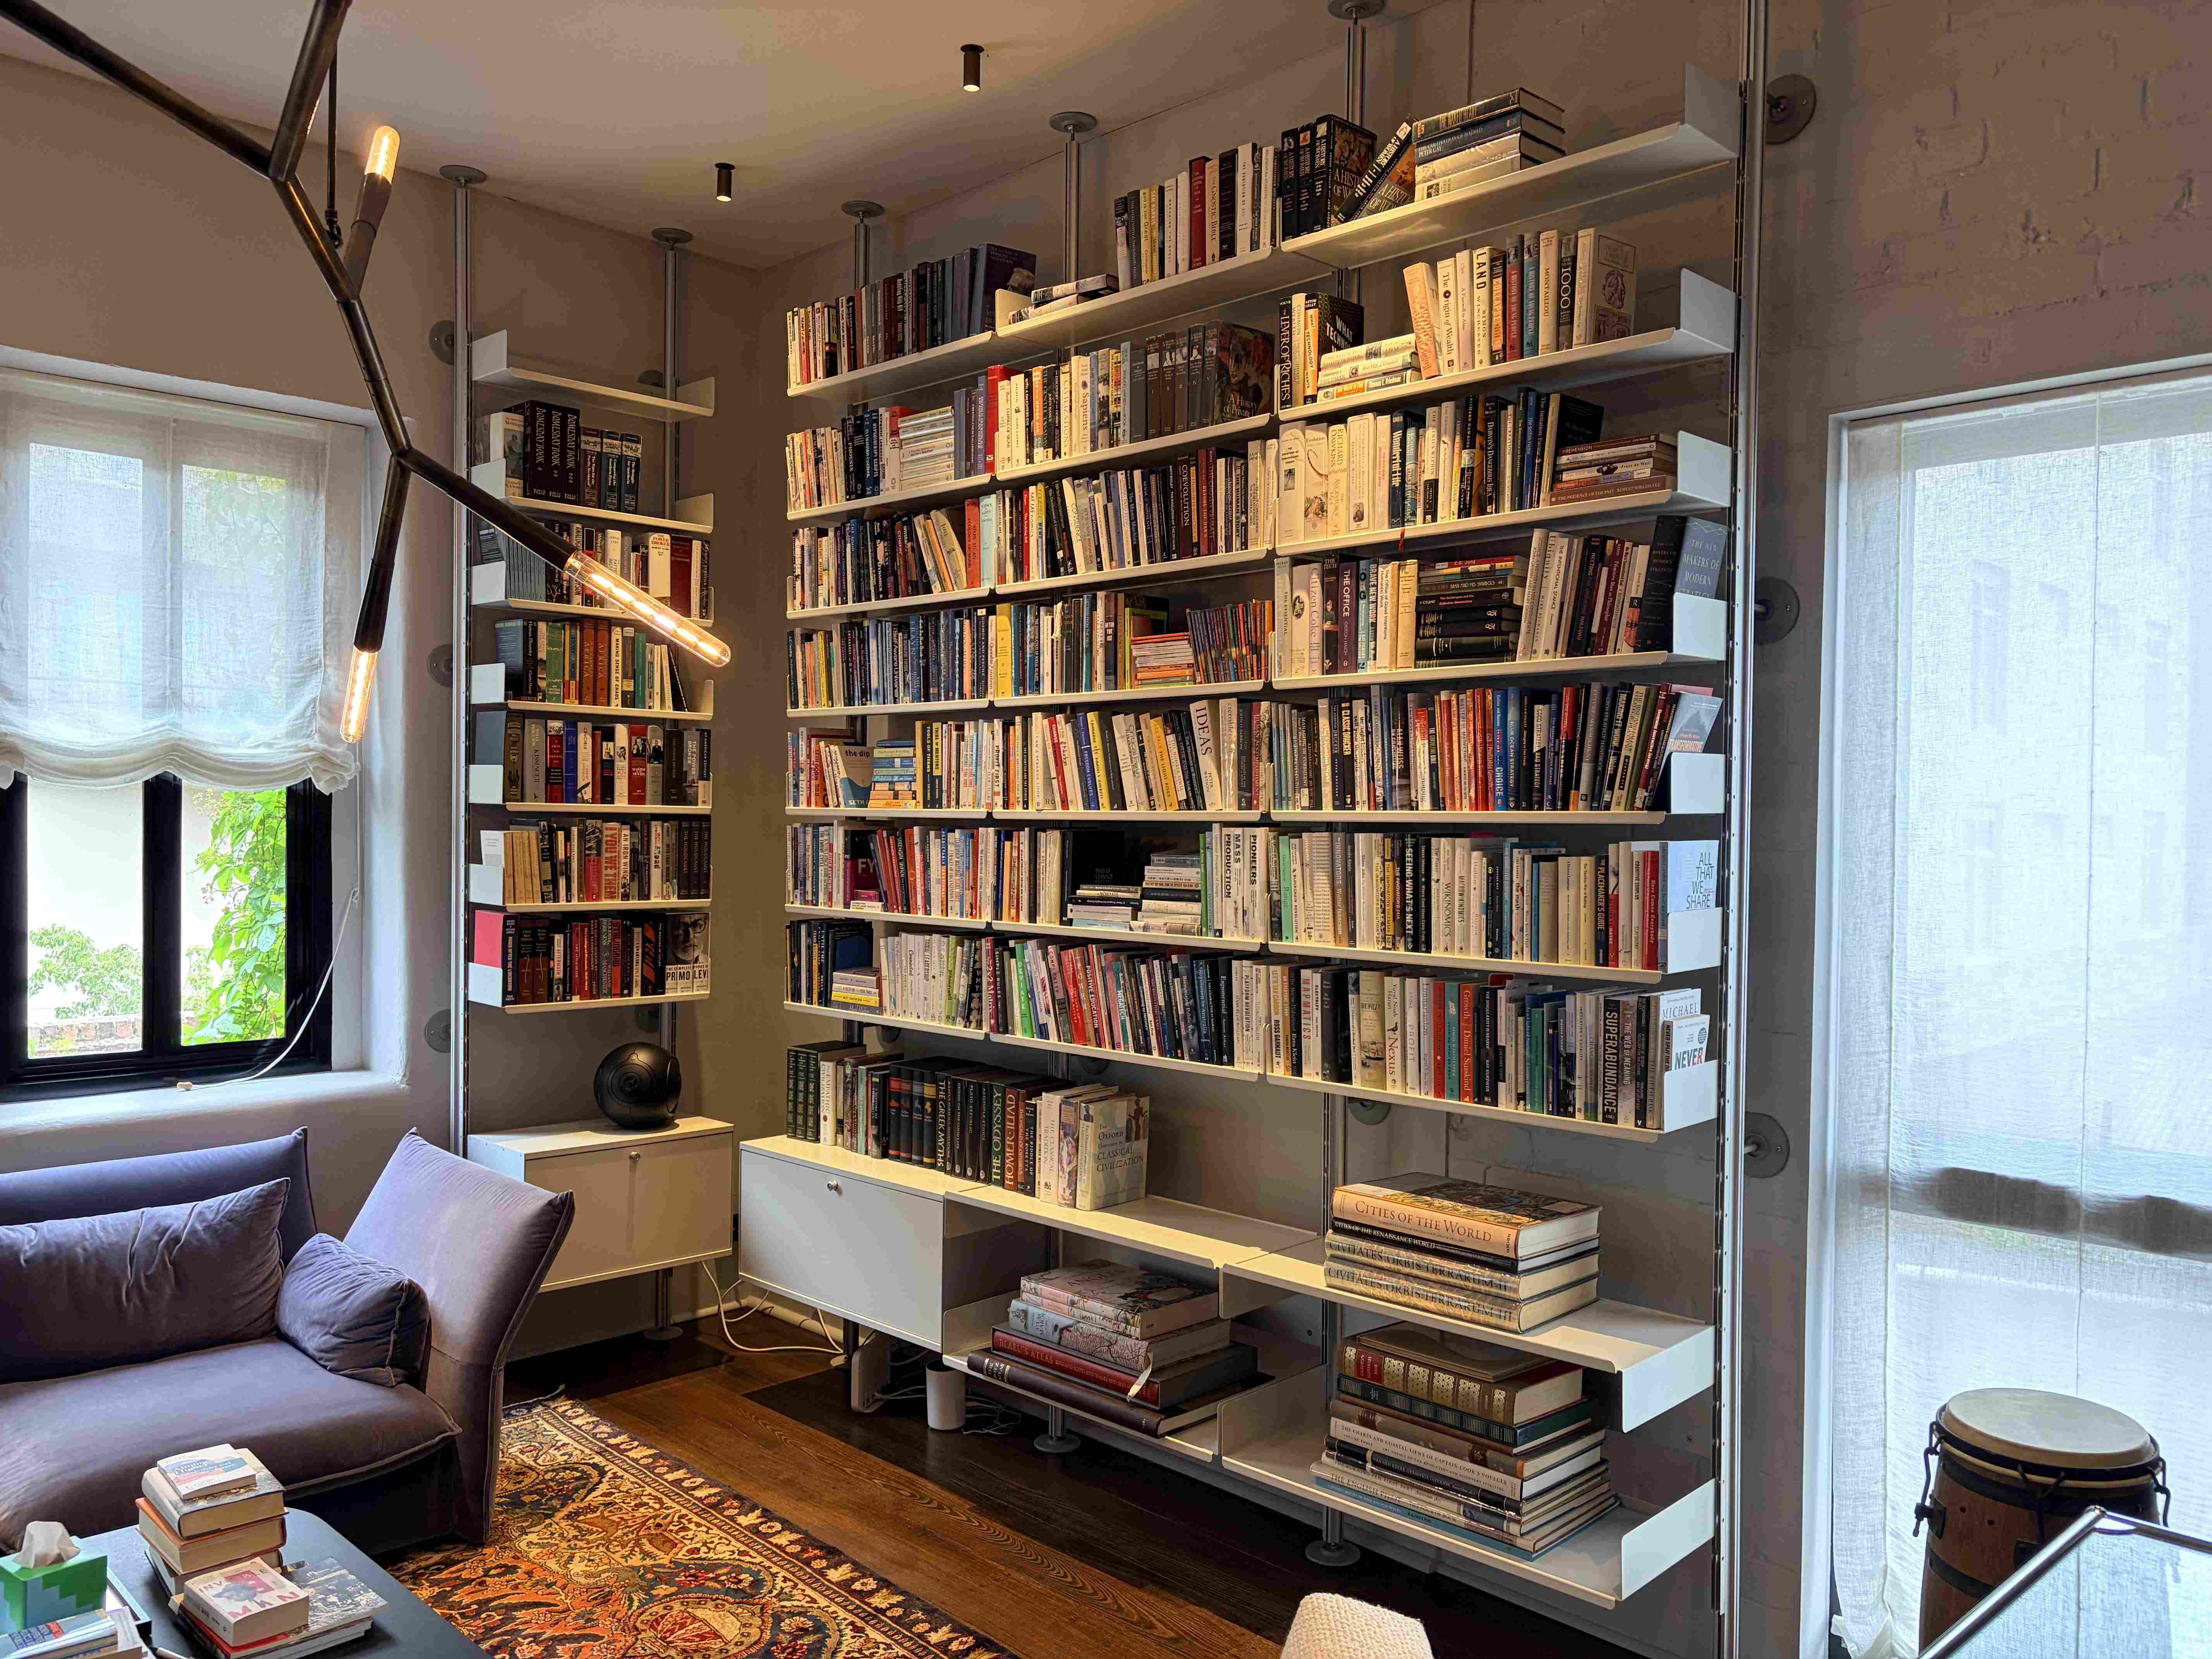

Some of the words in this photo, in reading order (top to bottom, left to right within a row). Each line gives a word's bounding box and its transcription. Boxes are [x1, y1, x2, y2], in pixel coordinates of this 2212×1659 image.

[1476, 252, 1486, 290] LAND
[1281, 316, 1290, 344] LEVER
[1336, 316, 1353, 342] WHAT
[1444, 320, 1451, 329] of
[1281, 345, 1290, 361] OF
[1281, 360, 1291, 401] RICHES
[567, 414, 577, 451] DOMESDAY
[567, 452, 575, 470] BOOK
[1562, 445, 1593, 454] PREHENSION
[1634, 483, 1661, 492] SHELDRAKE
[1072, 503, 1081, 542] CONSILIENCE
[1554, 556, 1563, 589] INTENTIONAL
[1684, 553, 1709, 568] MAKERS
[1711, 559, 1720, 570] OF
[1311, 568, 1320, 607] Citizen
[1685, 572, 1711, 586] MODERN
[1310, 610, 1319, 639] Coke
[1196, 707, 1212, 755] IDEAS
[1342, 710, 1350, 731] CLASSIC
[1343, 732, 1351, 755] DRUCKER
[1496, 768, 1504, 797] CHOICE
[1405, 848, 1413, 878] SEEING
[1696, 866, 1714, 880] THAT
[1698, 853, 1712, 866] ALL
[1405, 879, 1413, 912] WHAT'S
[1458, 876, 1466, 923] MACROWIKINOMICS
[1692, 881, 1704, 894] WE
[1686, 895, 1711, 909] SHARE
[1405, 913, 1413, 935] NEXT
[666, 972, 690, 981] PRIMO
[1018, 962, 1027, 1010] DEVIATE
[1117, 990, 1126, 1020] MEGATECH
[1302, 978, 1311, 1040] MAPMATICS
[1463, 991, 1471, 1019] Growth
[1662, 1003, 1698, 1019] MICHAEL
[1388, 1036, 1399, 1075] Nexus
[1605, 1012, 1618, 1114] SUPERABUNDANCE
[1674, 1048, 1704, 1070] NEVER
[1463, 1057, 1472, 1091] Susskind
[992, 1088, 1002, 1151] ODYSSEY
[1007, 1094, 1016, 1129] ILIAD
[1005, 1133, 1016, 1185] HOMER
[1097, 1146, 1134, 1160] CLASSICAL
[1097, 1156, 1143, 1171] CIVILIZATION
[992, 1155, 1001, 1181] THE
[1336, 1222, 1352, 1230] CITIES
[1360, 1227, 1372, 1235] THE
[1373, 1230, 1413, 1244] RENAISSANCE
[1413, 1240, 1436, 1249] WORLD
[1355, 1201, 1395, 1220] CITIES
[1398, 1212, 1413, 1224] OF
[1417, 1217, 1441, 1230] THE
[1443, 1220, 1492, 1242] WORLD
[1329, 1241, 1383, 1261] CIVITATES
[1387, 1255, 1421, 1271] ORBIS
[1425, 1264, 1493, 1288] TERRARUM
[1499, 1280, 1508, 1292] II
[1328, 1267, 1382, 1290] CIVITATES
[1386, 1284, 1421, 1299] ORBIS
[1425, 1293, 1493, 1317] TERRARUM
[1499, 1310, 1512, 1322] III
[999, 1340, 1029, 1355] BLAEU'S
[1031, 1350, 1053, 1364] ATLAS
[1353, 1428, 1372, 1439] CHARTS
[1385, 1439, 1407, 1449] COASTAL
[1409, 1446, 1425, 1457] VIEWS
[1435, 1456, 1458, 1469] CAPTAIN
[1482, 1472, 1508, 1485] VOYAGES
